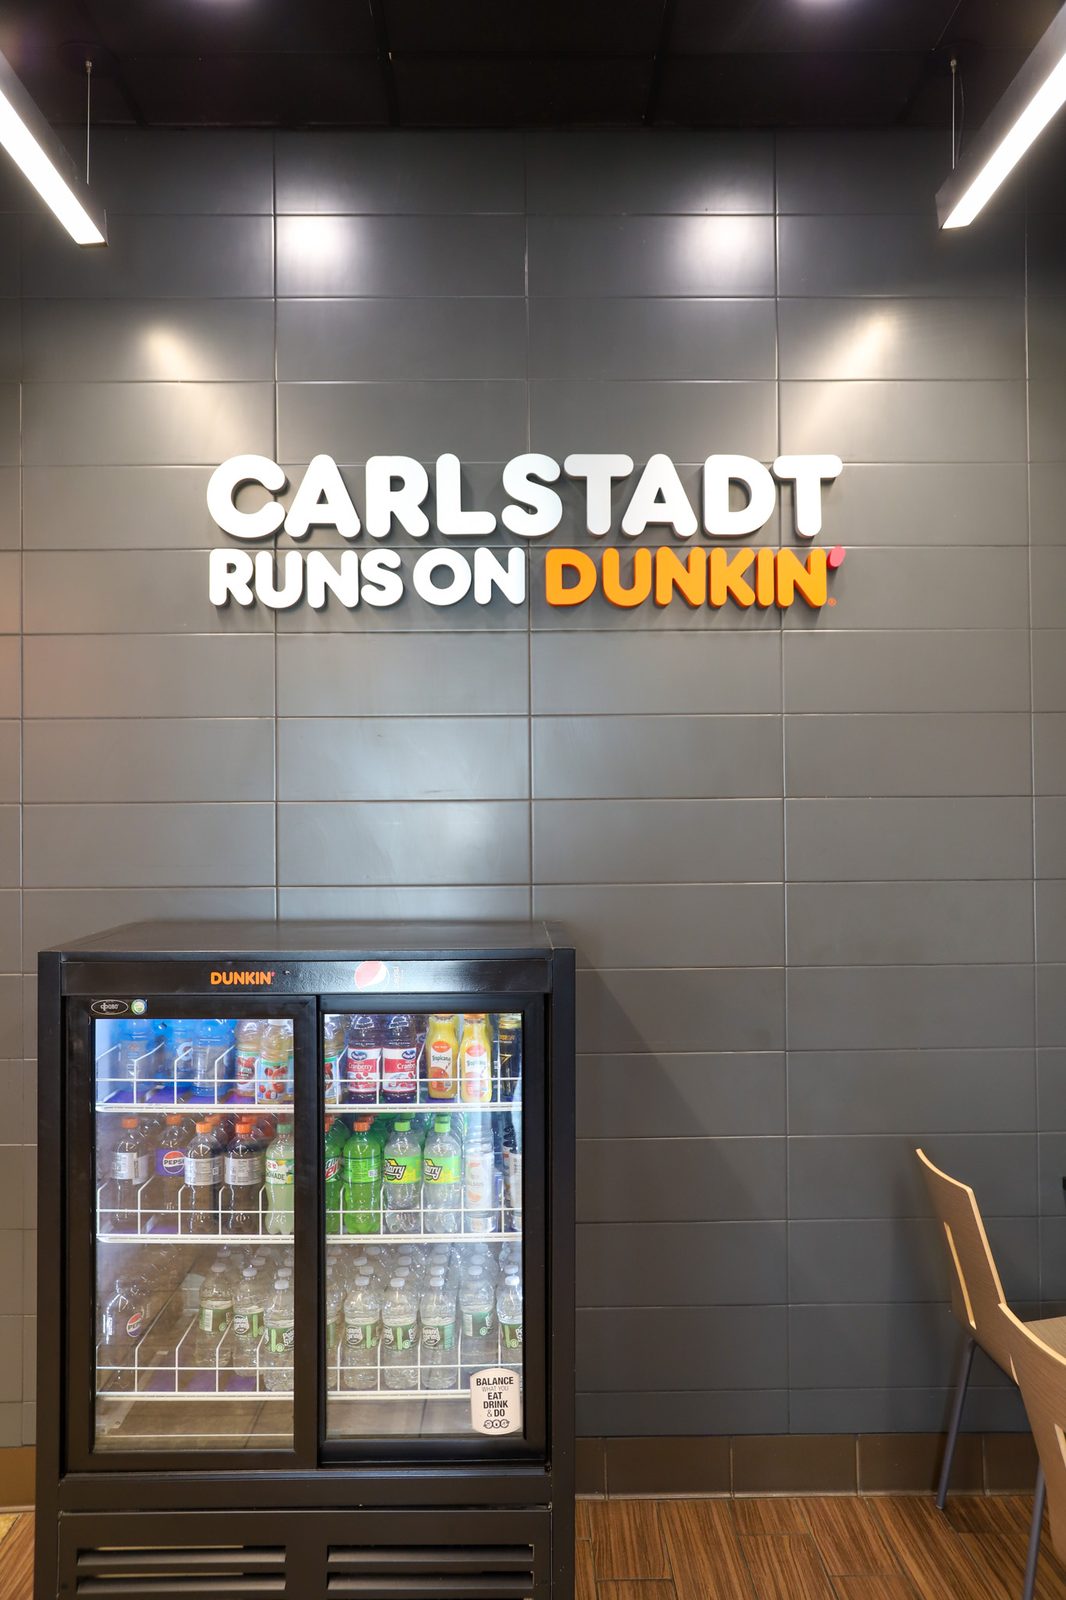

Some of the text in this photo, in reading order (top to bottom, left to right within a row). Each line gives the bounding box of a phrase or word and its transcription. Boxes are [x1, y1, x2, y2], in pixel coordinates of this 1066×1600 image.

[207, 453, 843, 539] CARLSTADT
[208, 544, 846, 609] RUNS ON DUNKIN'
[476, 1376, 514, 1386] BALANCE
[487, 1392, 503, 1400] EAT
[483, 1400, 508, 1409] DRINK
[486, 1409, 506, 1417] & DO
